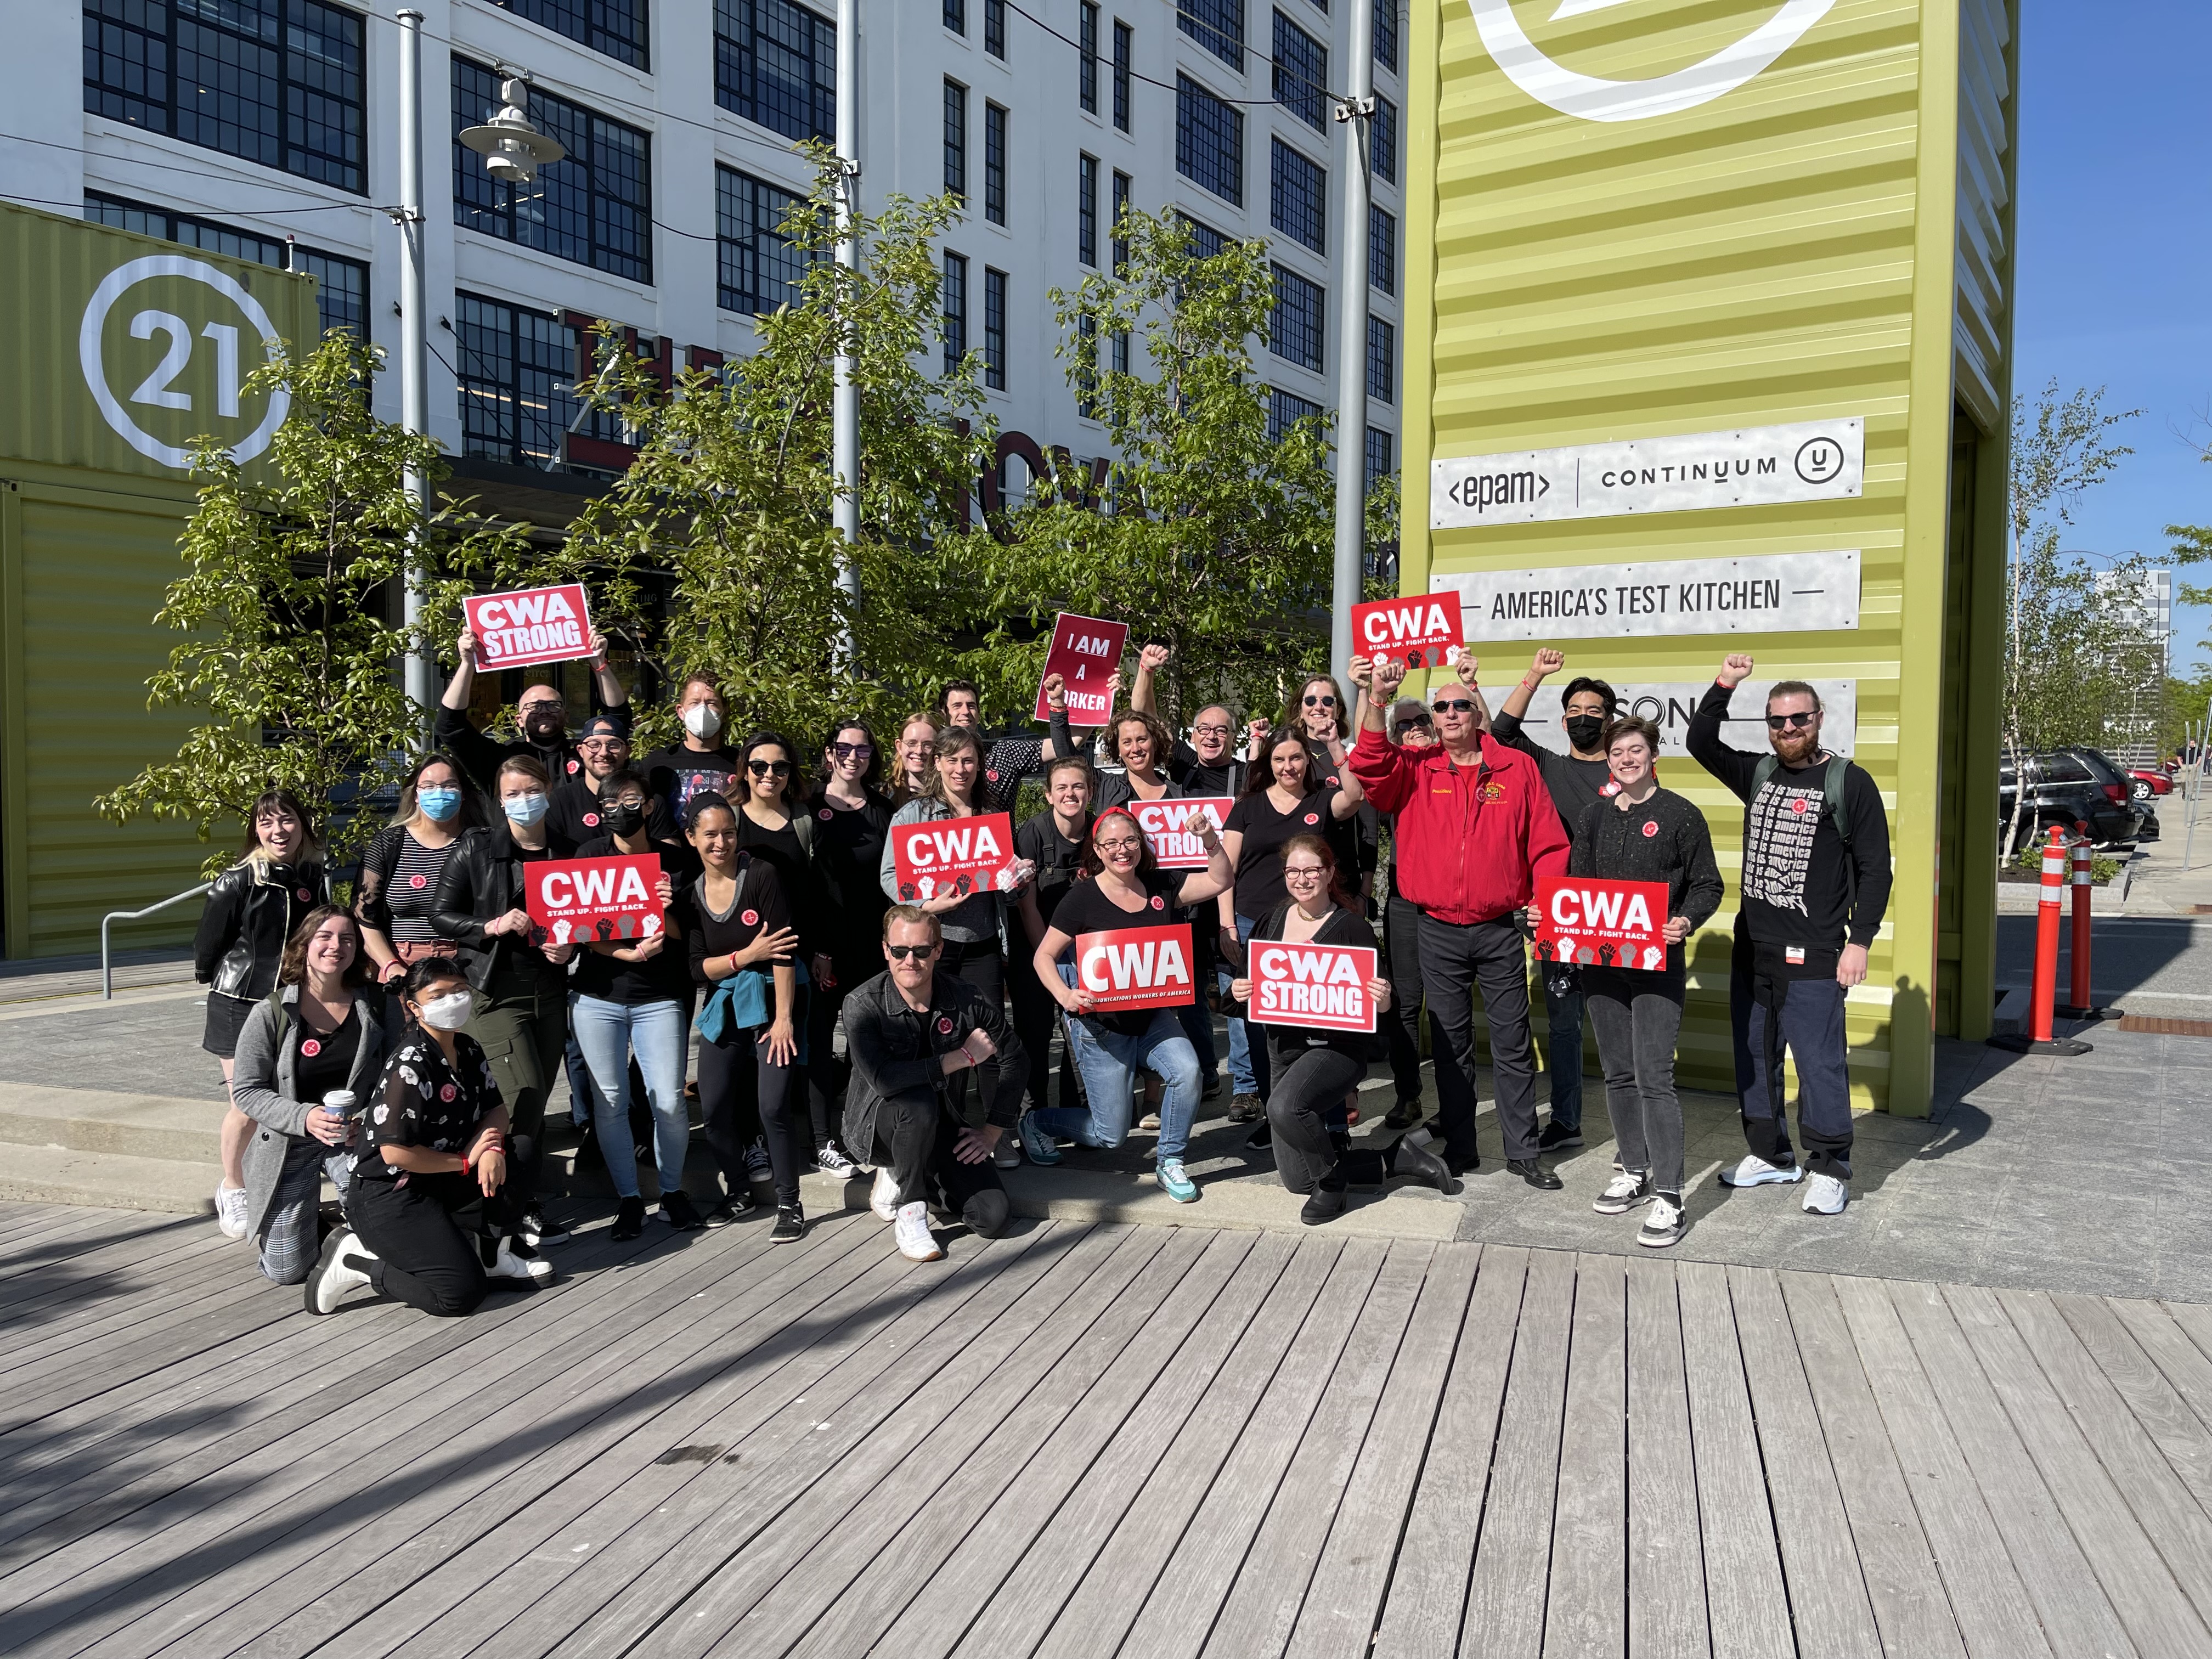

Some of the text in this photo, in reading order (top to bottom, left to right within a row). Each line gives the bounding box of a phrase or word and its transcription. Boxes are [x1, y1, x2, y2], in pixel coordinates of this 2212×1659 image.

[129, 309, 240, 419] 21
[1601, 456, 1777, 488] CONTINUUM
[1491, 578, 1781, 620] AMERICA'S TEST KITCHEN
[477, 592, 576, 630] CWA
[1364, 603, 1452, 643] CWA
[483, 620, 583, 657] STRONG
[1067, 633, 1110, 657] I AM
[1368, 643, 1391, 651] STAND
[1406, 638, 1426, 647] FIGHT
[1428, 635, 1450, 644] BACK.
[1075, 664, 1086, 681] A
[1047, 690, 1106, 711] RKER
[1769, 794, 1781, 806] is
[1775, 785, 1786, 795] is
[1138, 804, 1223, 833] CWA
[1766, 804, 1776, 817] is
[1762, 827, 1771, 841] is
[1771, 831, 1814, 847] america
[1764, 816, 1774, 829] is
[1774, 820, 1817, 836] america
[907, 826, 1002, 867] CWA
[1759, 839, 1768, 852] is
[1769, 843, 1812, 859] america
[913, 866, 937, 874] STAND
[954, 862, 976, 871] FIGHT
[978, 859, 1001, 867] BACK.
[1756, 864, 1764, 876] is
[1757, 851, 1766, 864] is
[1768, 855, 1809, 872] america
[541, 867, 650, 909] CWA
[546, 909, 575, 917] STAND
[594, 905, 619, 913] FIGHT
[621, 903, 647, 912] BACK.
[1551, 889, 1654, 932] CWA
[1554, 927, 1581, 935] STAND
[1599, 930, 1624, 939] FIGHT
[1625, 932, 1650, 941] BACK.
[1081, 940, 1190, 992] CWA
[1260, 949, 1362, 986] CWA
[1260, 980, 1363, 1017] STRONG
